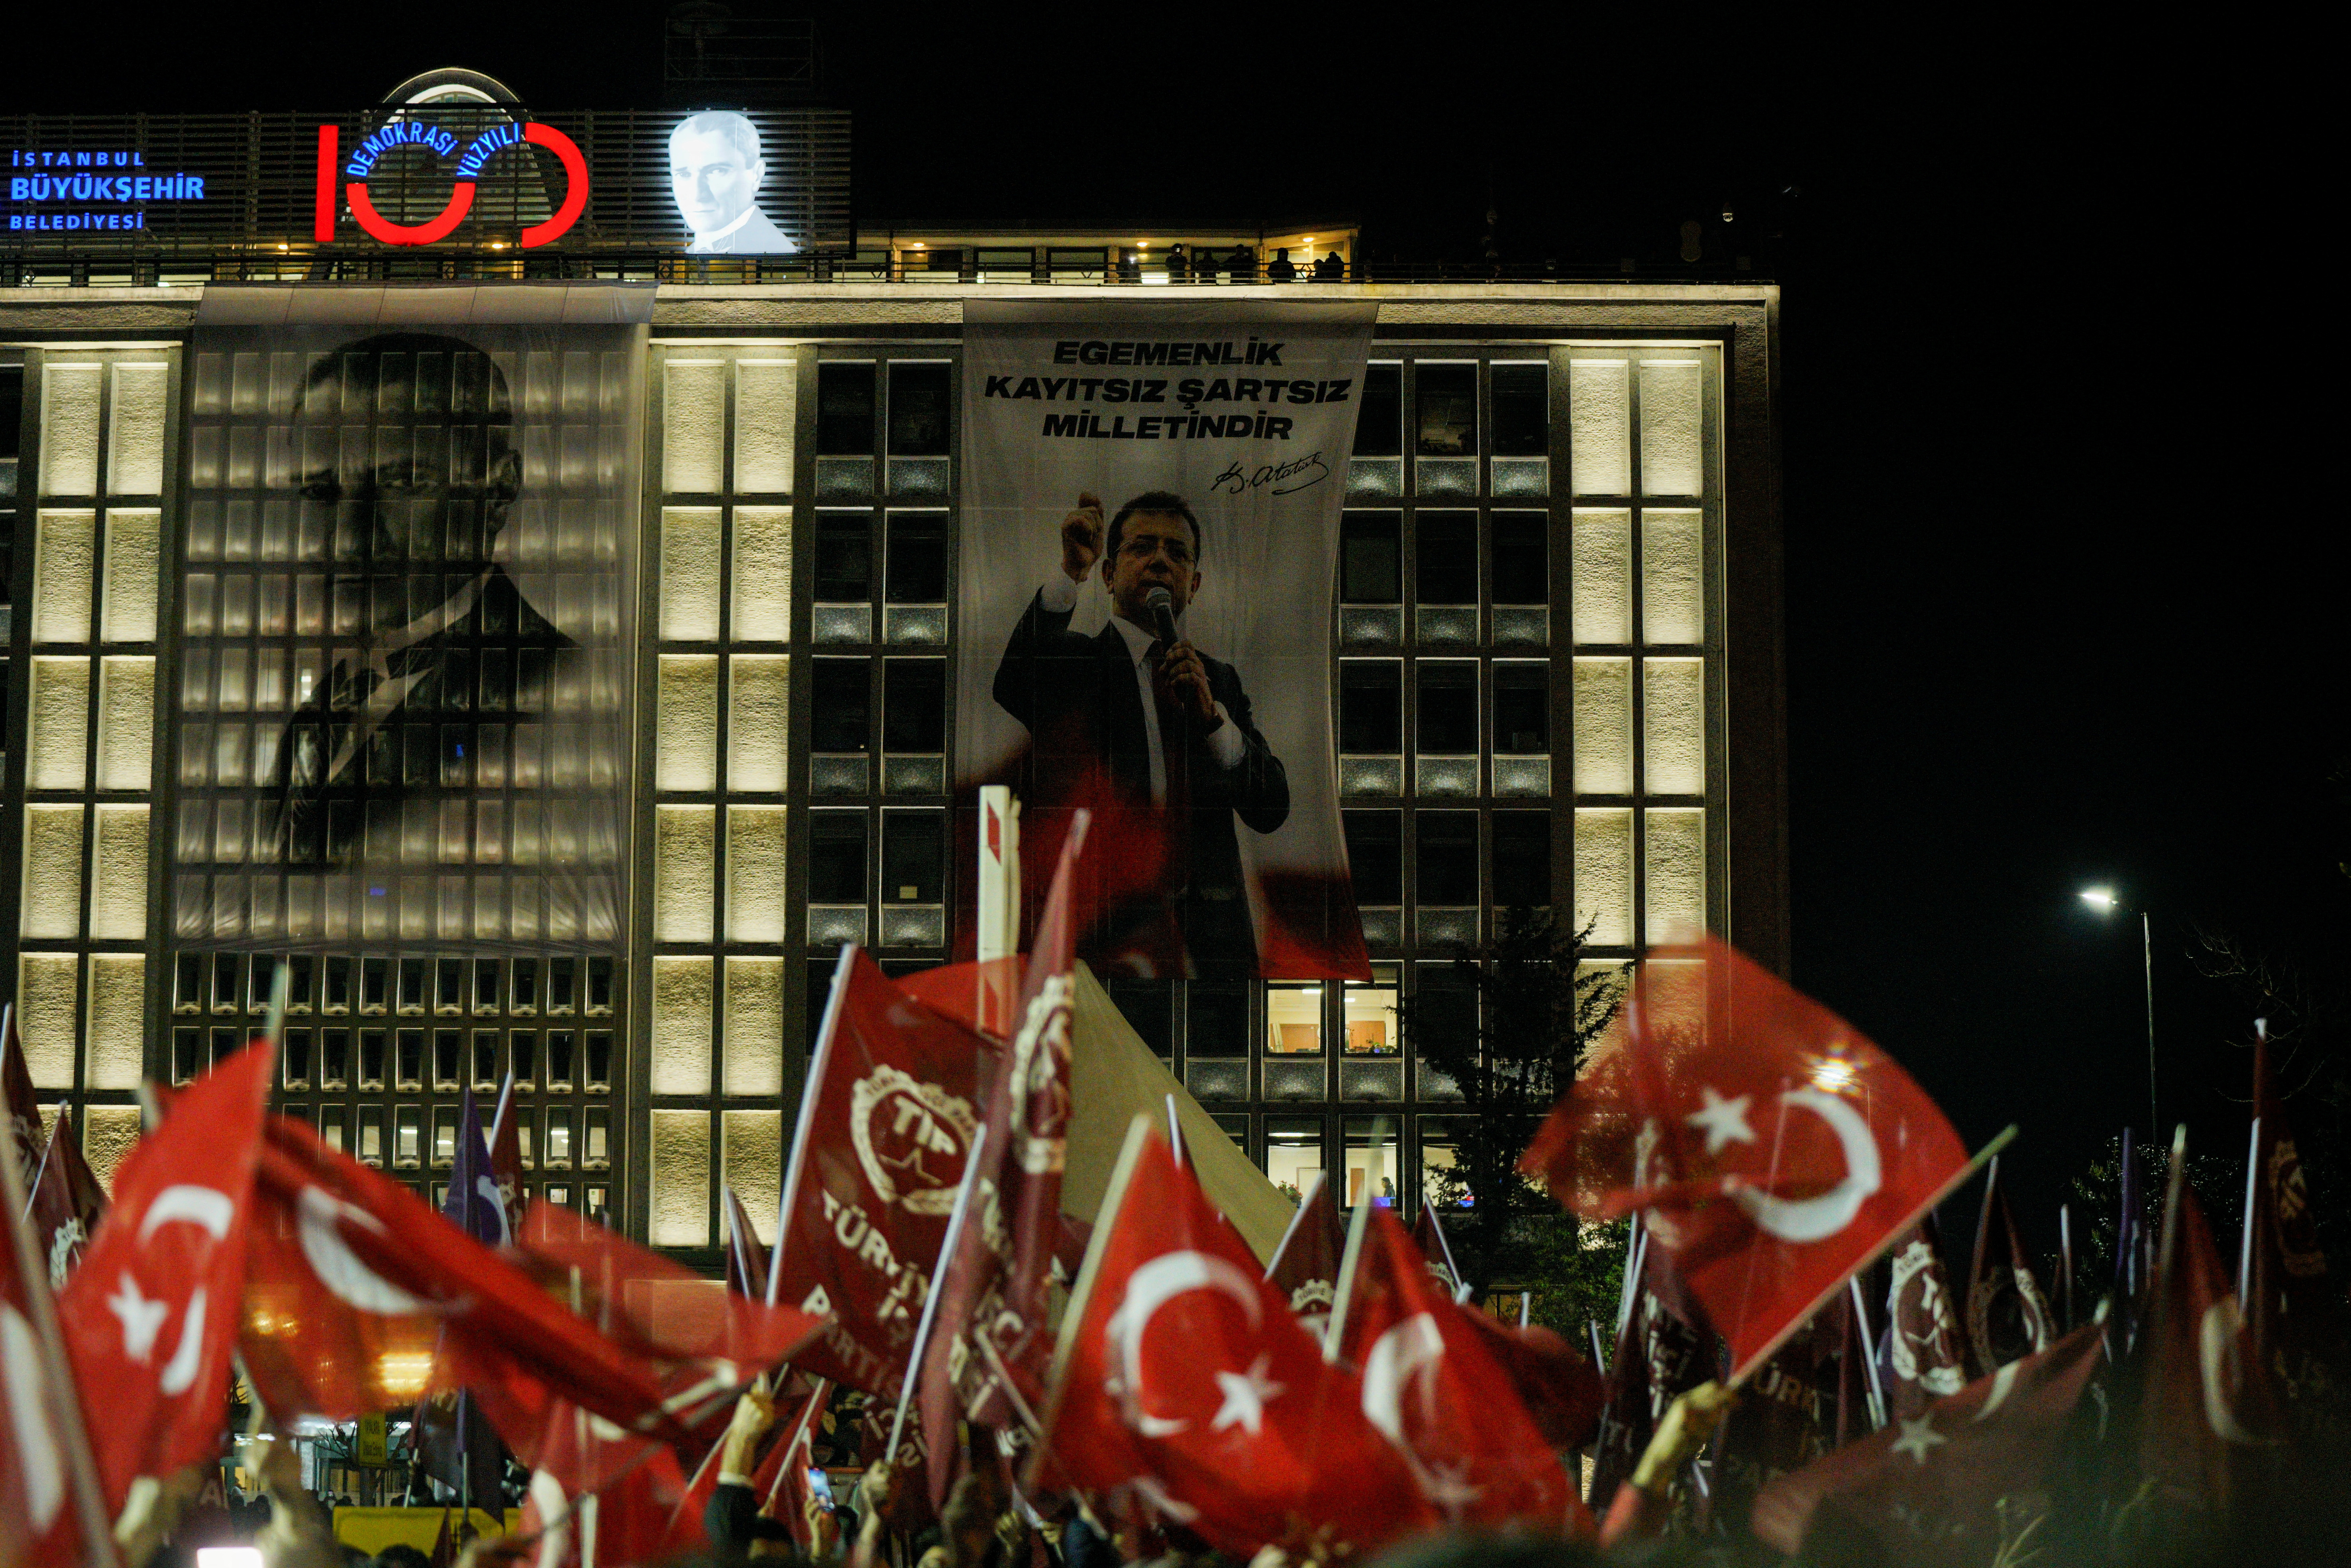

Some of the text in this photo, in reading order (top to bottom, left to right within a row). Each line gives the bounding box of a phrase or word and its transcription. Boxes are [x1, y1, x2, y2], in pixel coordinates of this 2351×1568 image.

[13, 150, 144, 167] İSTANBUL
[456, 122, 519, 177] YÜZYILI
[11, 172, 204, 202] BÜYÜKŞEHİR
[10, 212, 143, 230] BELEDİYESİ
[1052, 336, 1285, 366] EGEMENLİK
[985, 375, 1352, 410] KAYITSIZ ŞARTSIZ
[1042, 410, 1293, 440] MİLLETİNDİR
